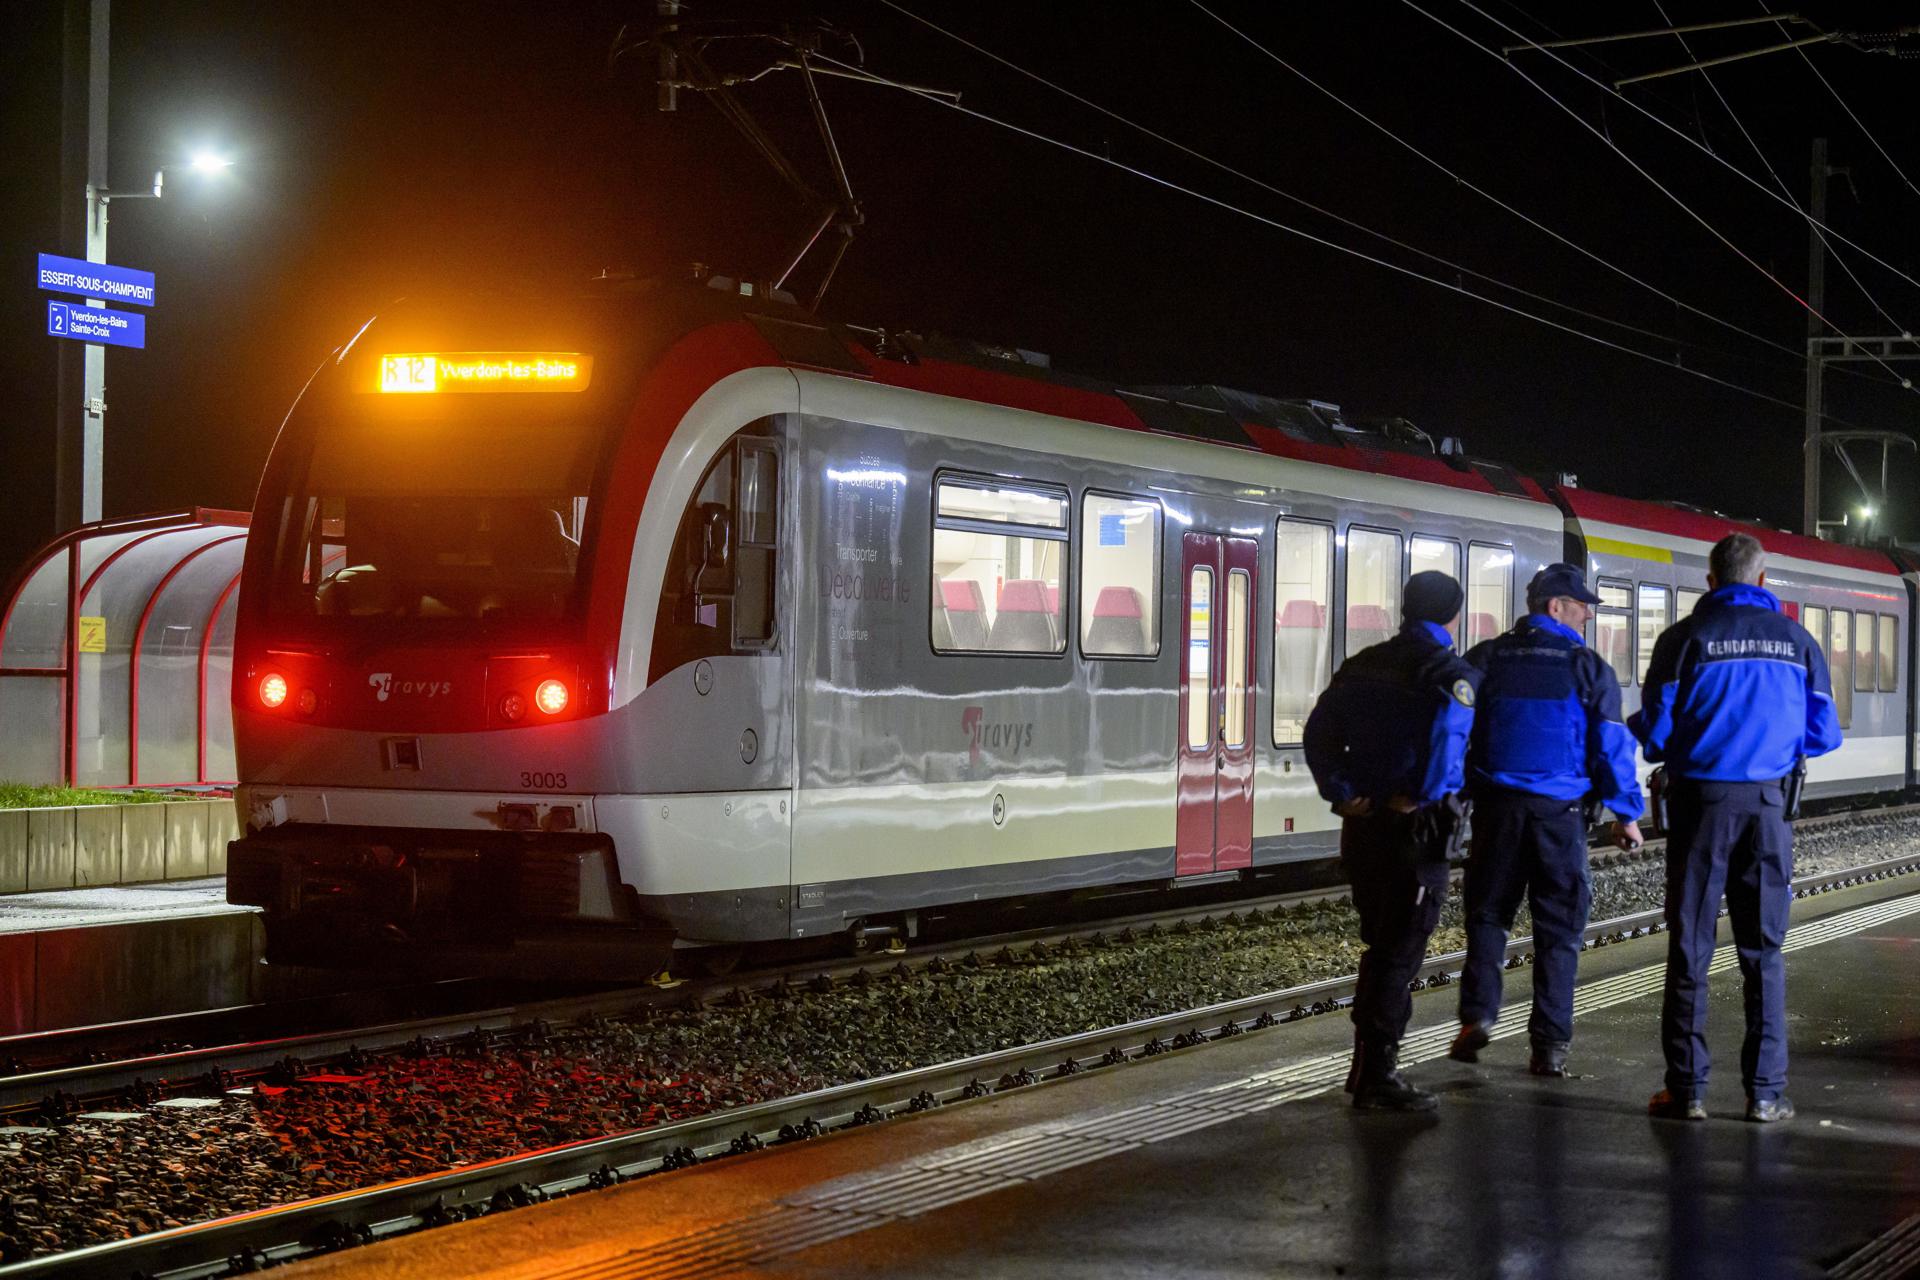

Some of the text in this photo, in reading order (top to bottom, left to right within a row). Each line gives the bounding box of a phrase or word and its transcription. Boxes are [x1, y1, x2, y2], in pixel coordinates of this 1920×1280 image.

[40, 269, 153, 300] ESSERT-SOUS-CHAMPVENT
[55, 315, 63, 330] 2
[70, 309, 128, 328] Yverdon-les-Bains
[70, 322, 110, 337] Sainte-Croix
[406, 357, 425, 384] 12
[440, 360, 576, 378] Yverdon-les-Bains
[836, 542, 878, 562] Transporter
[839, 625, 869, 641] Ouverture
[1707, 639, 1796, 657] GENDARMERIE
[371, 674, 451, 700] travys
[966, 708, 1033, 761] travys
[520, 771, 569, 790] 3003
